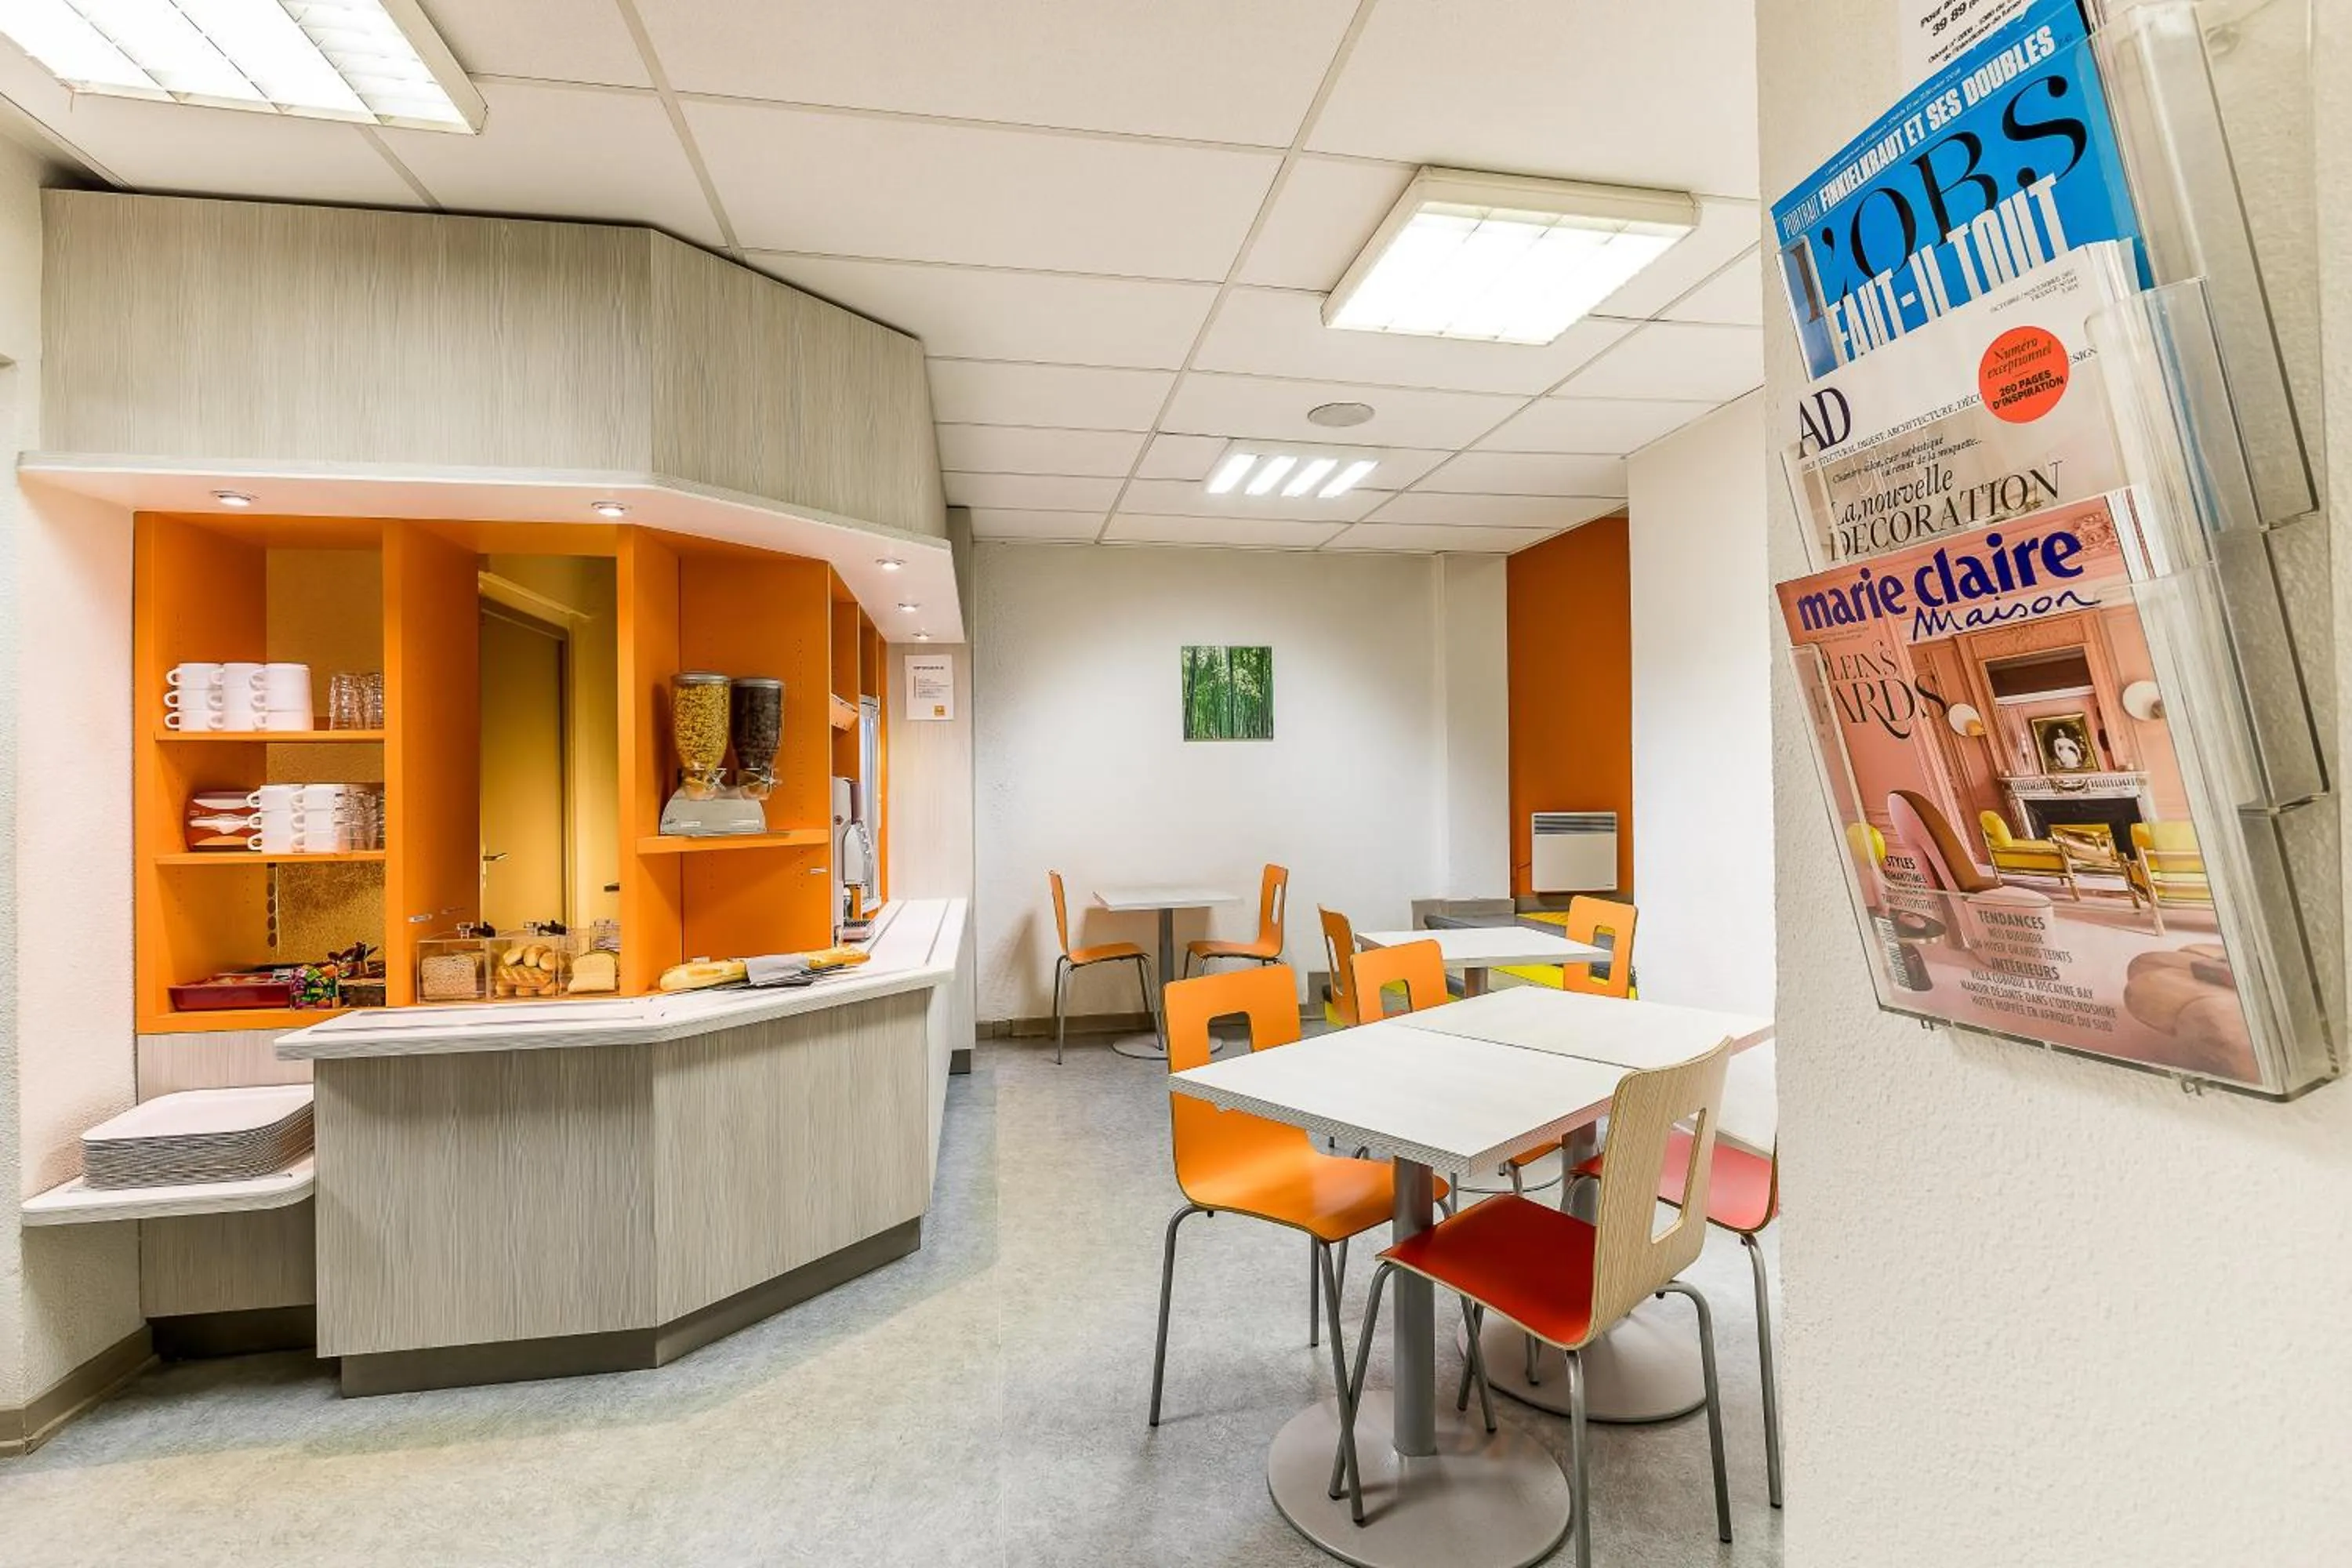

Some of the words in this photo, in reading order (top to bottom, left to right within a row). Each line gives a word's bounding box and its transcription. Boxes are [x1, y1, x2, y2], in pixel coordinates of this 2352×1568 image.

[1933, 16, 1947, 36] 39
[1951, 2, 1967, 22] 89
[1782, 194, 1821, 239] PORTRAIT
[1818, 128, 1906, 212] FINKIELKRAUT
[1904, 112, 1926, 147] ET
[1926, 88, 1962, 131] SES
[1962, 25, 2056, 107] DOUBLES
[1947, 172, 2070, 301] TOUT
[1987, 340, 2053, 379] exceptionnel
[1994, 338, 2038, 361] Numéro
[1992, 376, 2064, 410] D'INSPIRATION
[1999, 383, 2017, 397] 260
[2019, 370, 2051, 389] PAGES
[1798, 387, 1852, 459] AD
[1861, 463, 1954, 518] nouvelle
[1797, 568, 1907, 631] marie
[1913, 531, 2083, 608] claire
[1913, 590, 2102, 641] Maison
[1885, 855, 1915, 869] STYLES
[1977, 910, 2045, 930] TENDANCES
[2035, 979, 2074, 998] BISCAYNE
[2075, 987, 2092, 999] BAY
